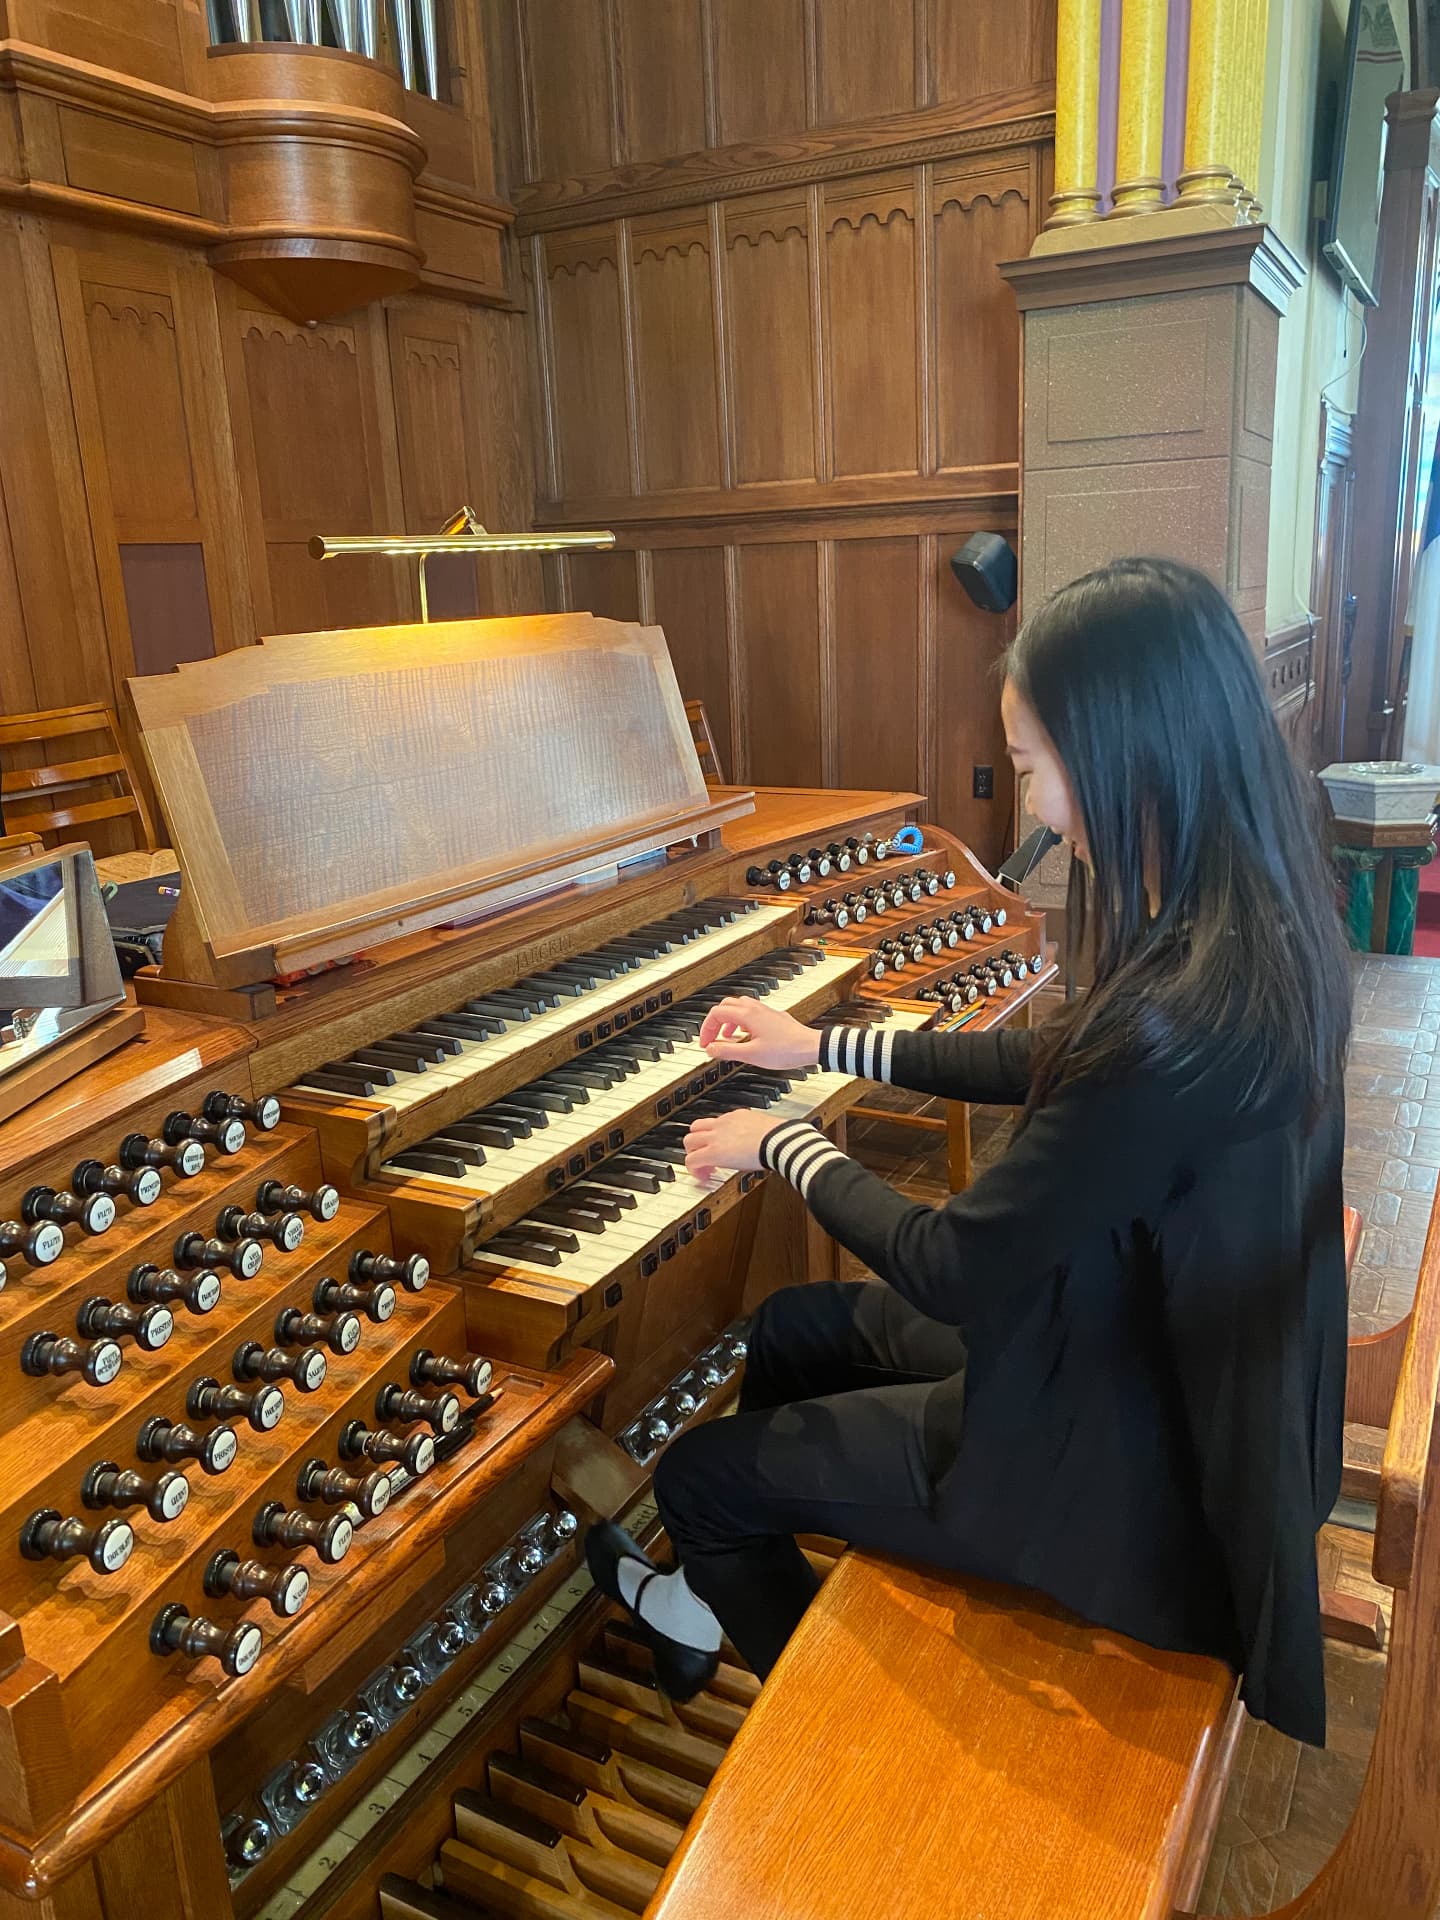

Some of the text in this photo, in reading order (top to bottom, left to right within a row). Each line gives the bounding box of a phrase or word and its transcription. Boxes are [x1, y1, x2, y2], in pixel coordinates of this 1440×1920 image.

[567, 1587, 583, 1597] 8
[533, 1623, 547, 1633] 7
[497, 1663, 513, 1674] 6
[458, 1706, 473, 1717] 5
[368, 1802, 386, 1815] 3
[319, 1856, 338, 1871] 2
